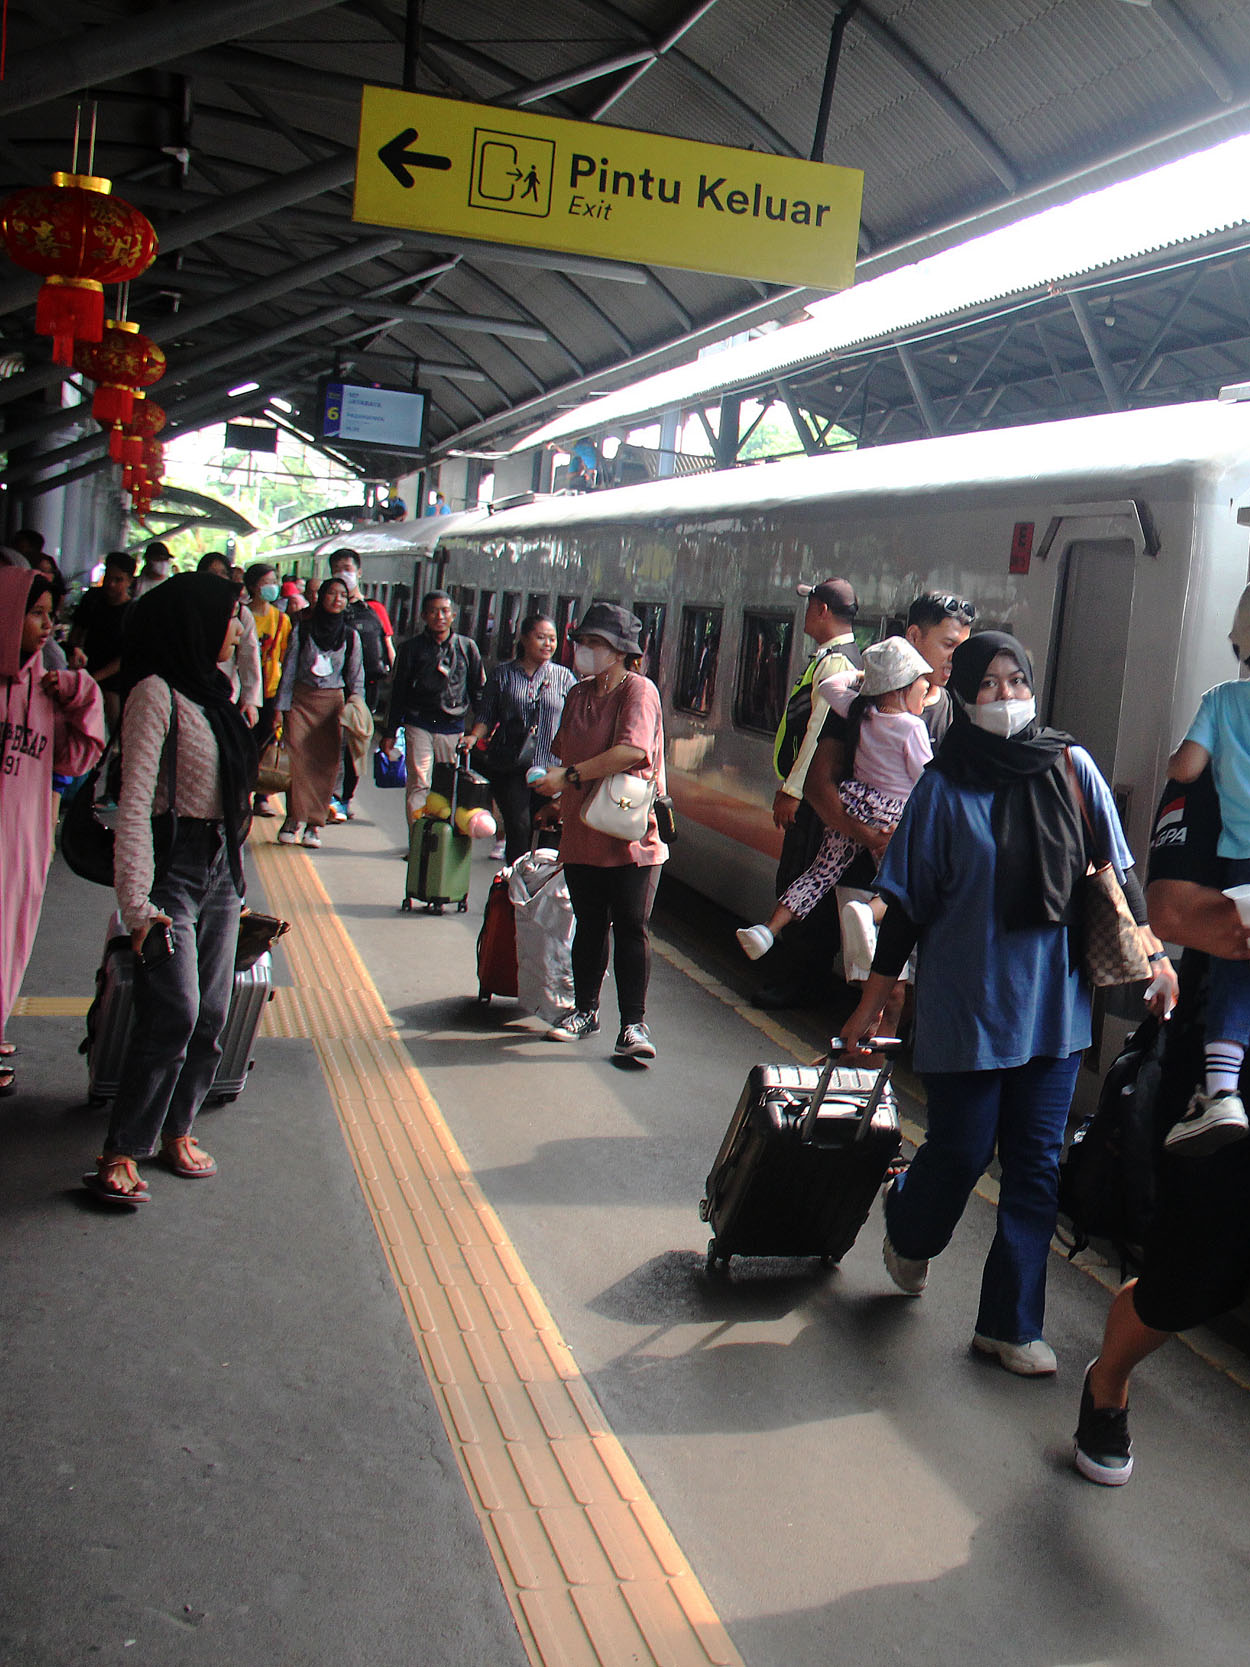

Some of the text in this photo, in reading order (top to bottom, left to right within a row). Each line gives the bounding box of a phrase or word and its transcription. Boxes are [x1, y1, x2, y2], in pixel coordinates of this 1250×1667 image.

[569, 153, 830, 227] Pintu Keluar
[567, 195, 613, 221] Exit
[327, 407, 339, 420] 6
